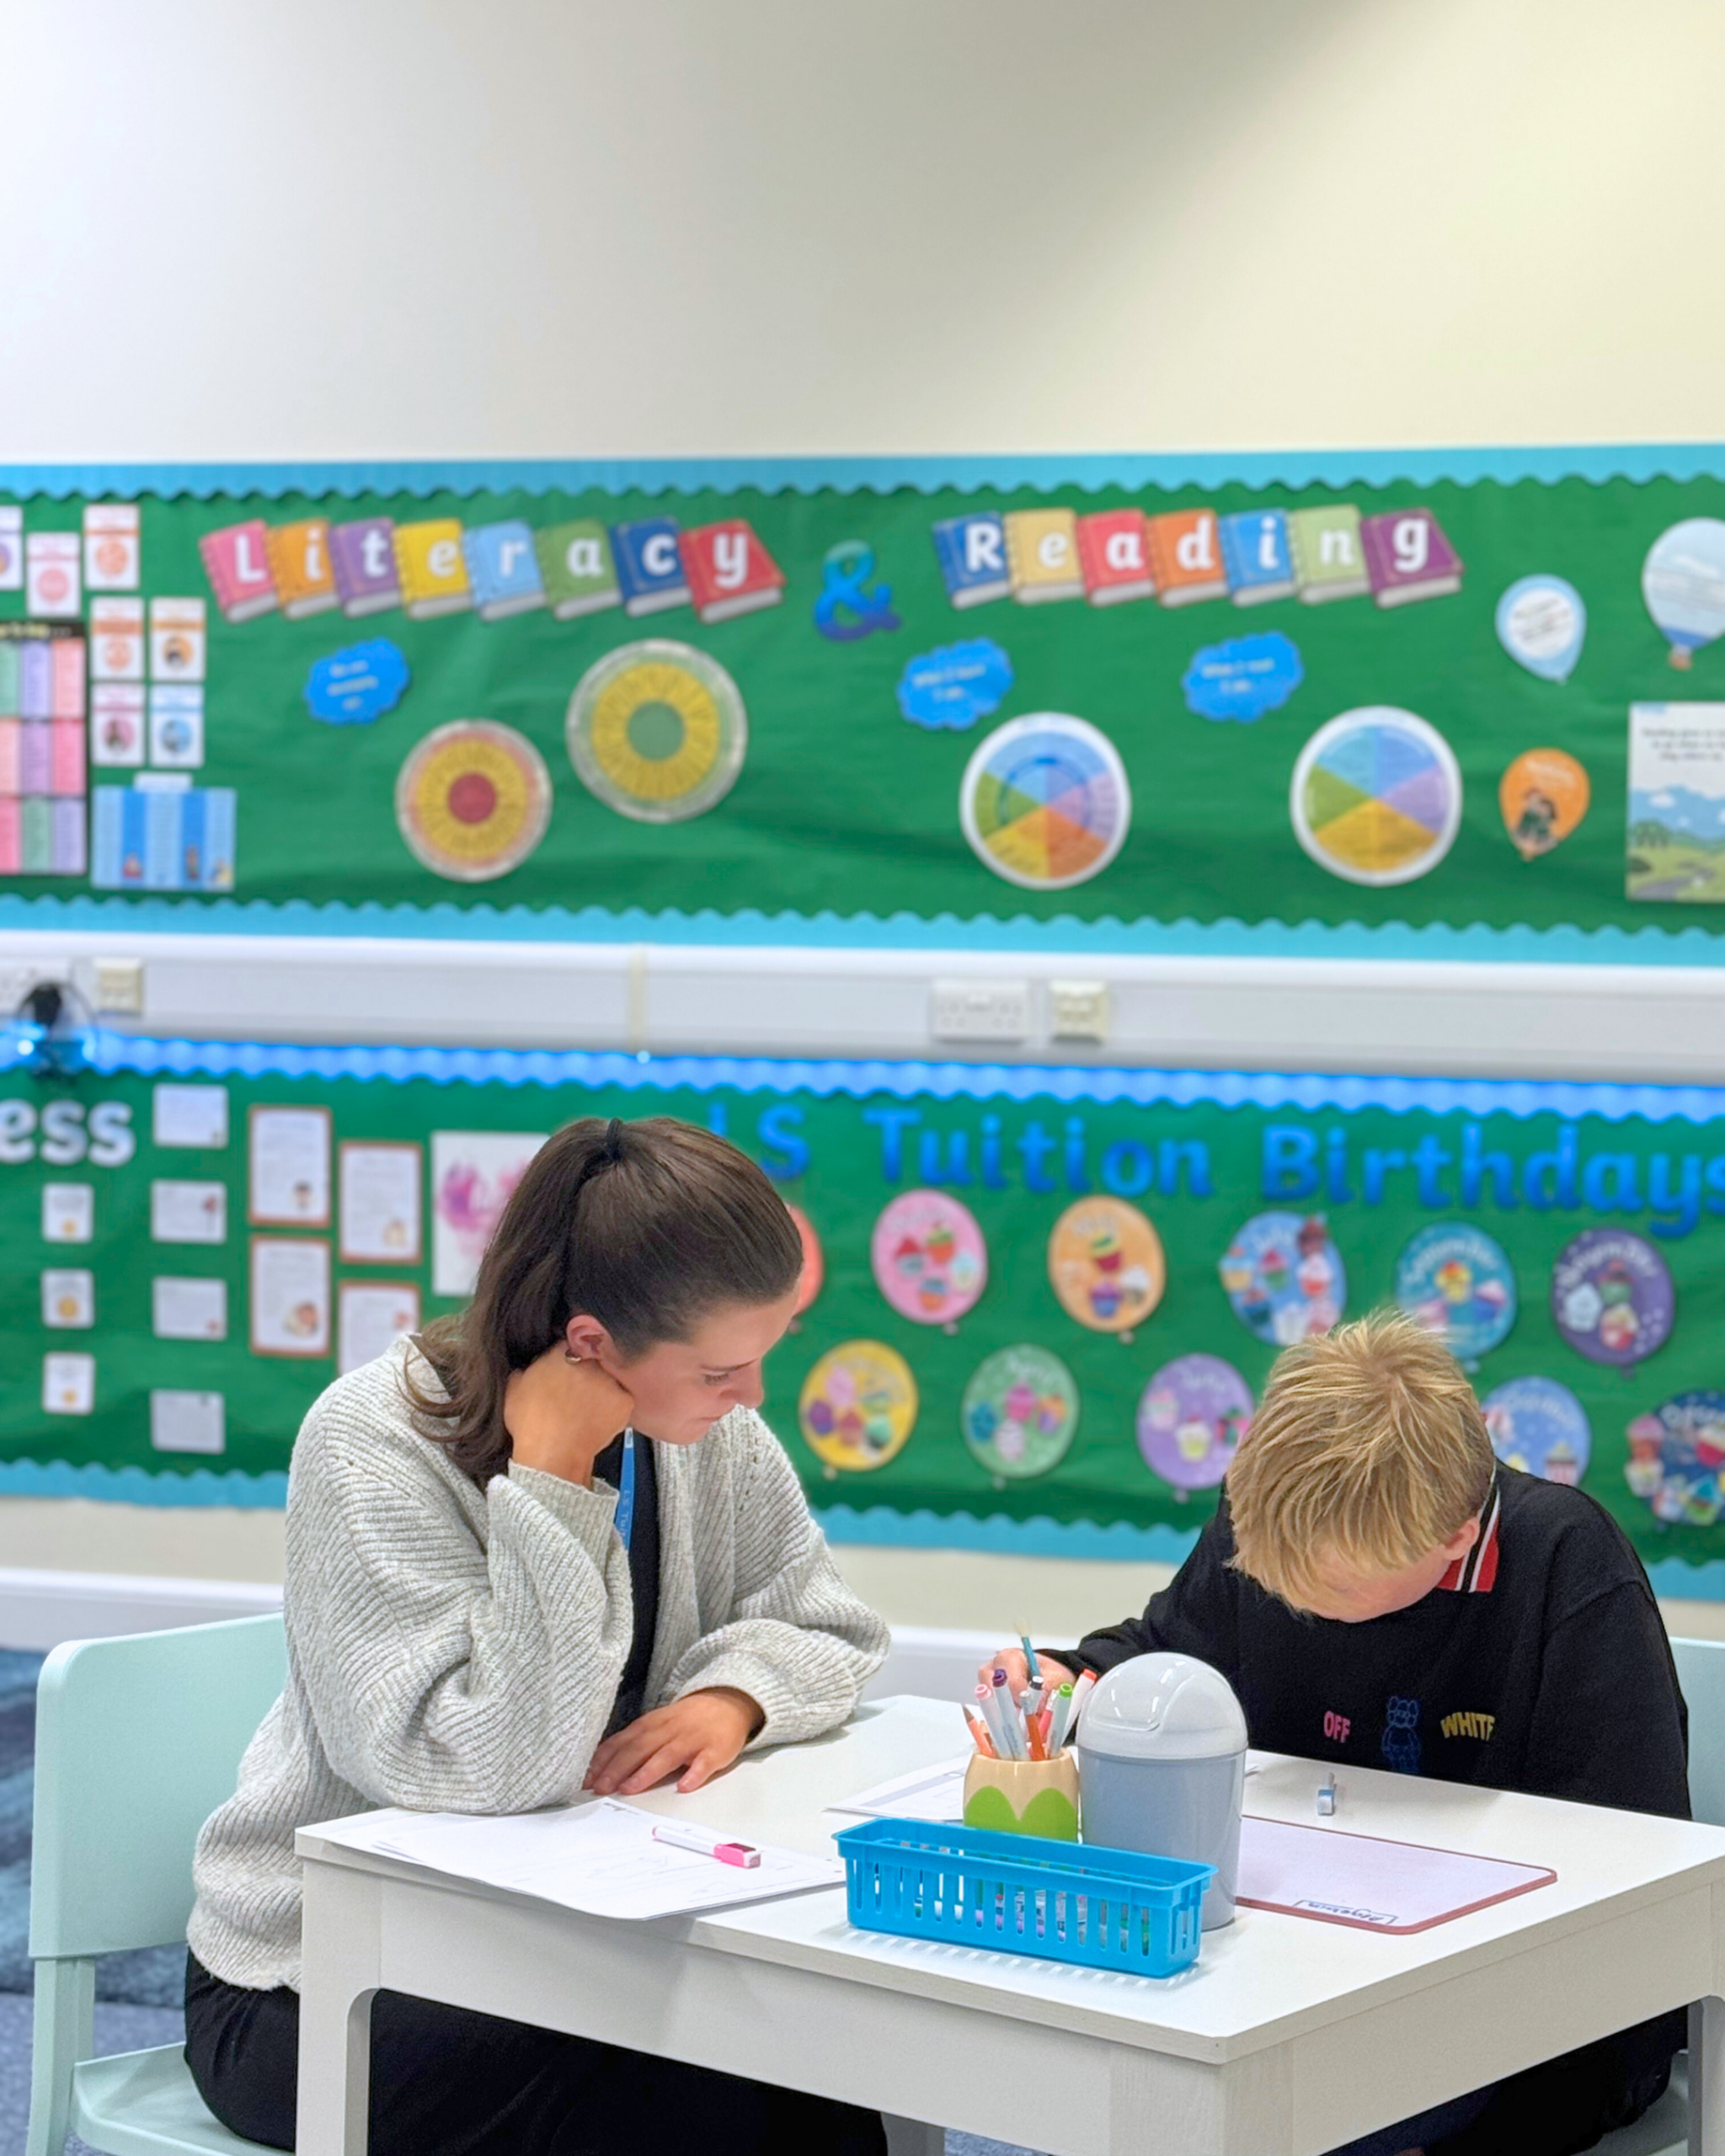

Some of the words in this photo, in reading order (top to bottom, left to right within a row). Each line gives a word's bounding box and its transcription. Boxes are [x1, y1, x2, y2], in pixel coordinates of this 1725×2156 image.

[235, 528, 747, 589] Literacy
[814, 540, 903, 643] &
[965, 515, 1429, 572] Reading
[0, 1097, 136, 1168] ess
[862, 1108, 1214, 1198] Tuition
[1555, 1240, 1659, 1289] November
[1323, 1710, 1351, 1743] OFF
